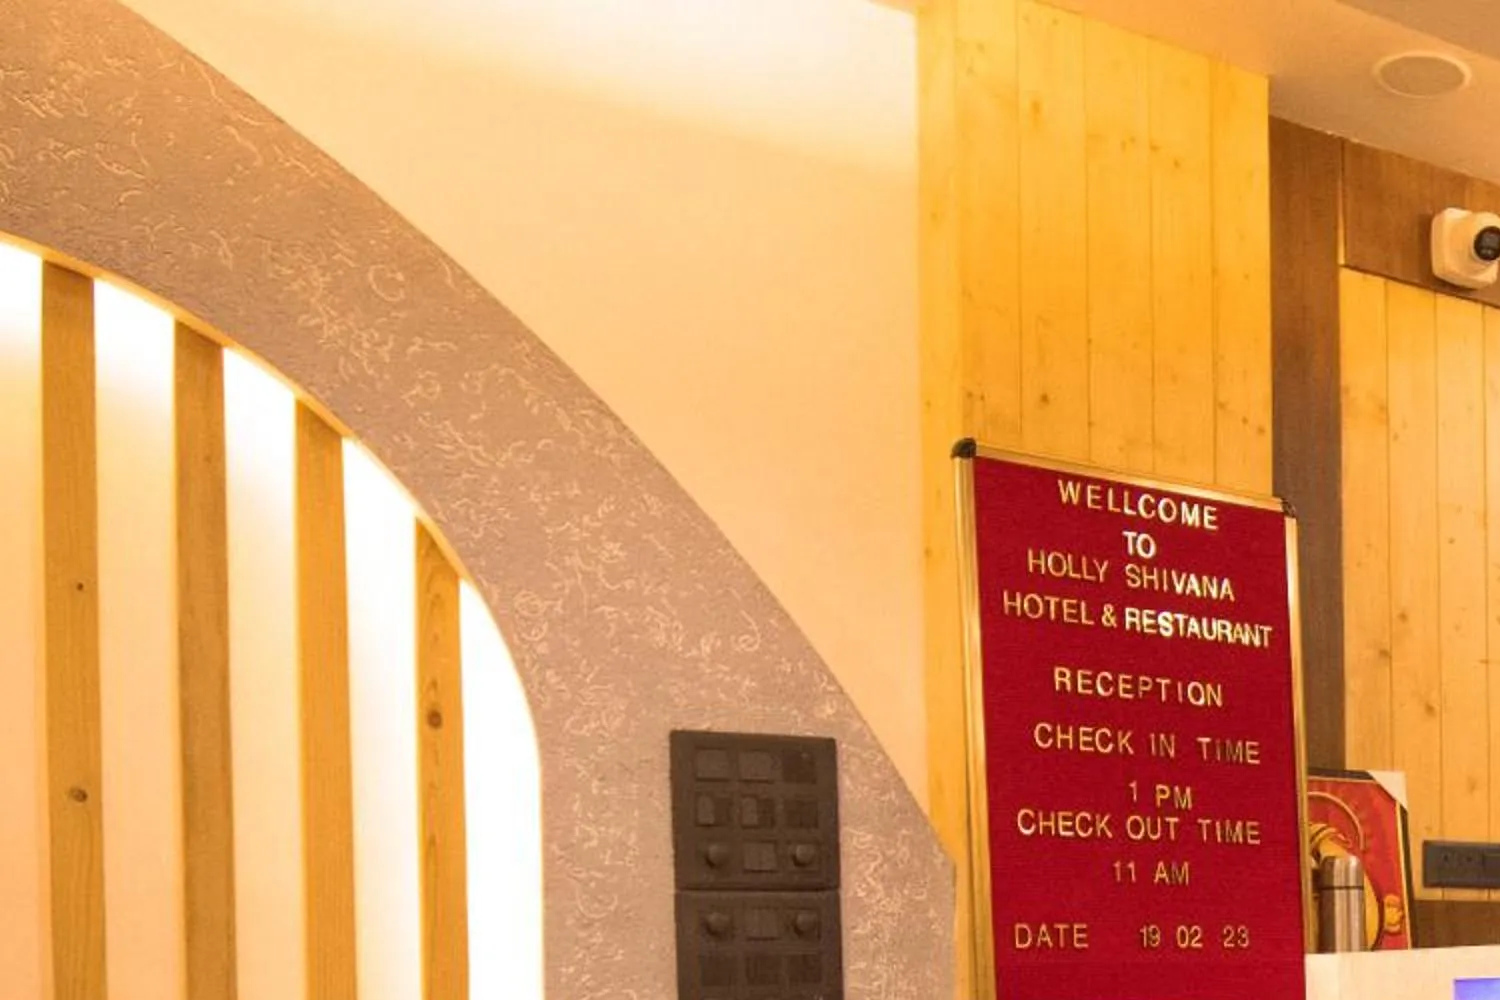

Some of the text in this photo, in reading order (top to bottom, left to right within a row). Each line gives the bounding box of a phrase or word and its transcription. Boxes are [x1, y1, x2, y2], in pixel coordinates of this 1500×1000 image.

[1058, 479, 1219, 531] WELLCOME
[1122, 531, 1156, 559] TO
[1027, 548, 1235, 602] HOLLY SHIVANA
[1003, 590, 1272, 648] HOTEL & RESTAURANT
[1054, 667, 1223, 708] RECEPTION
[1034, 723, 1261, 764] CHECK IN TIME
[1129, 781, 1193, 810] 1 PM
[1017, 809, 1261, 845] CHECK OUT TIME
[1113, 861, 1189, 886] 11 AM
[1014, 924, 1250, 949] DATE 19 02 23
